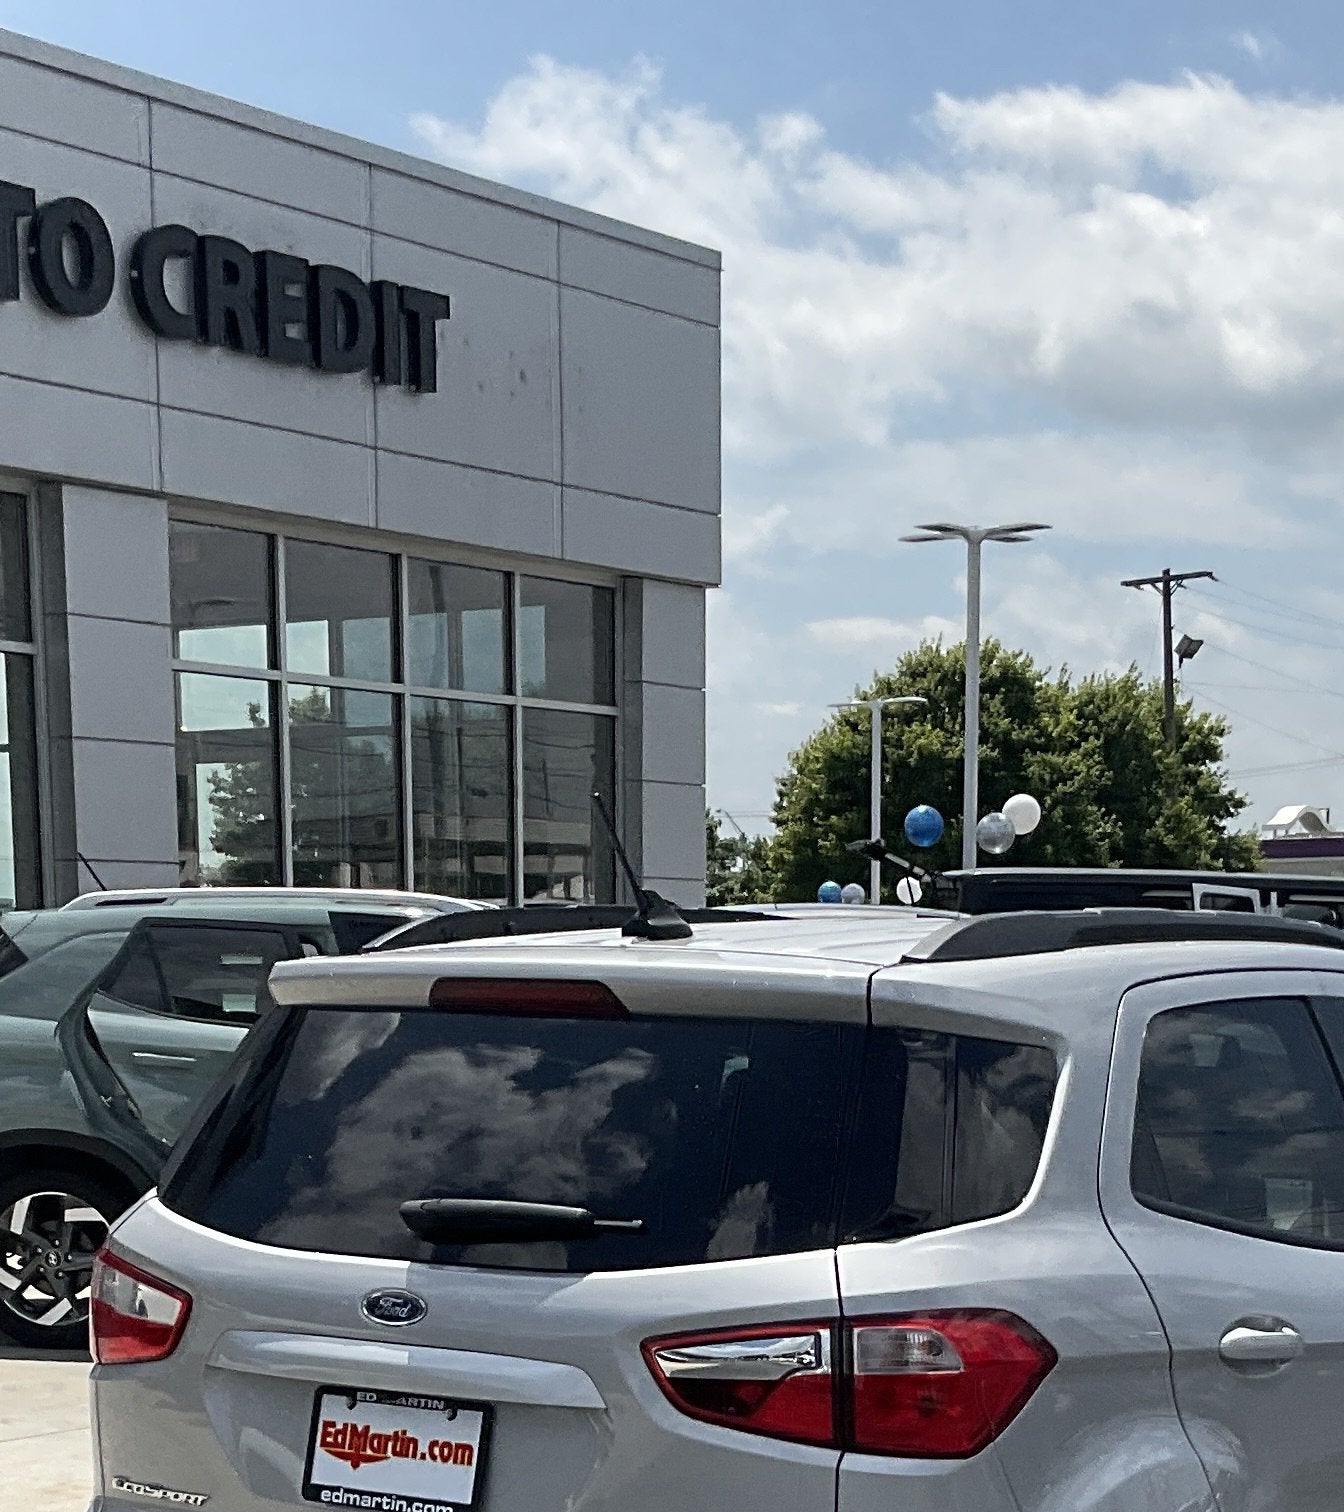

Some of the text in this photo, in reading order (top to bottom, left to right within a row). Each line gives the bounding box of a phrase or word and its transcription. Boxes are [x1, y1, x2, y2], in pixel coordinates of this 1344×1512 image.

[131, 224, 450, 393] CREDIT
[375, 1297, 412, 1318] Ford
[319, 1419, 475, 1467] EdMartin.com
